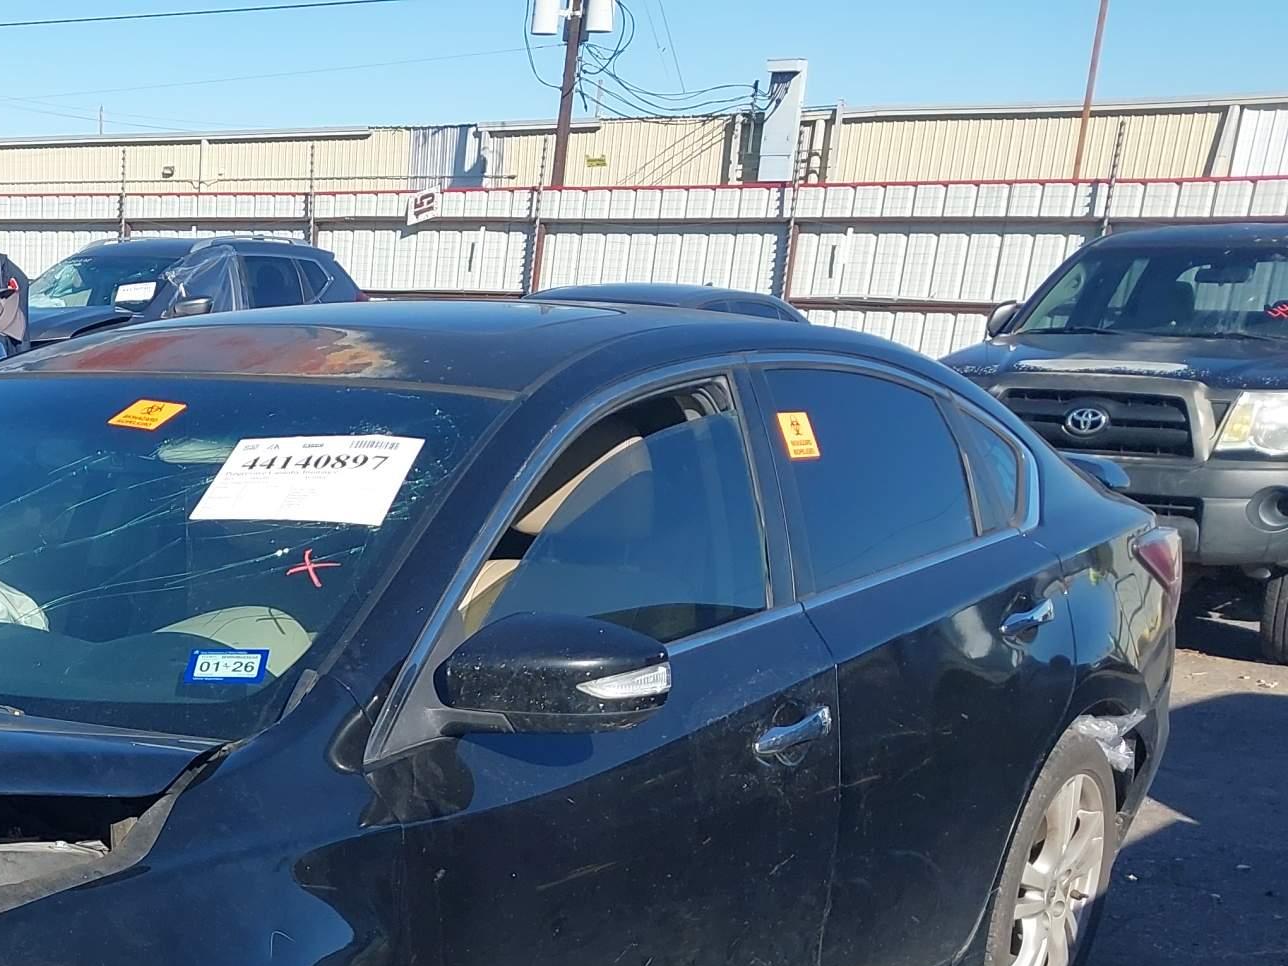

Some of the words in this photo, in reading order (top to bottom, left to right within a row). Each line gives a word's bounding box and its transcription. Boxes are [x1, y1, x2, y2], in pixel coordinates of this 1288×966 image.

[241, 454, 389, 470] 44140897
[199, 661, 220, 673] 01
[231, 661, 255, 673] 26
